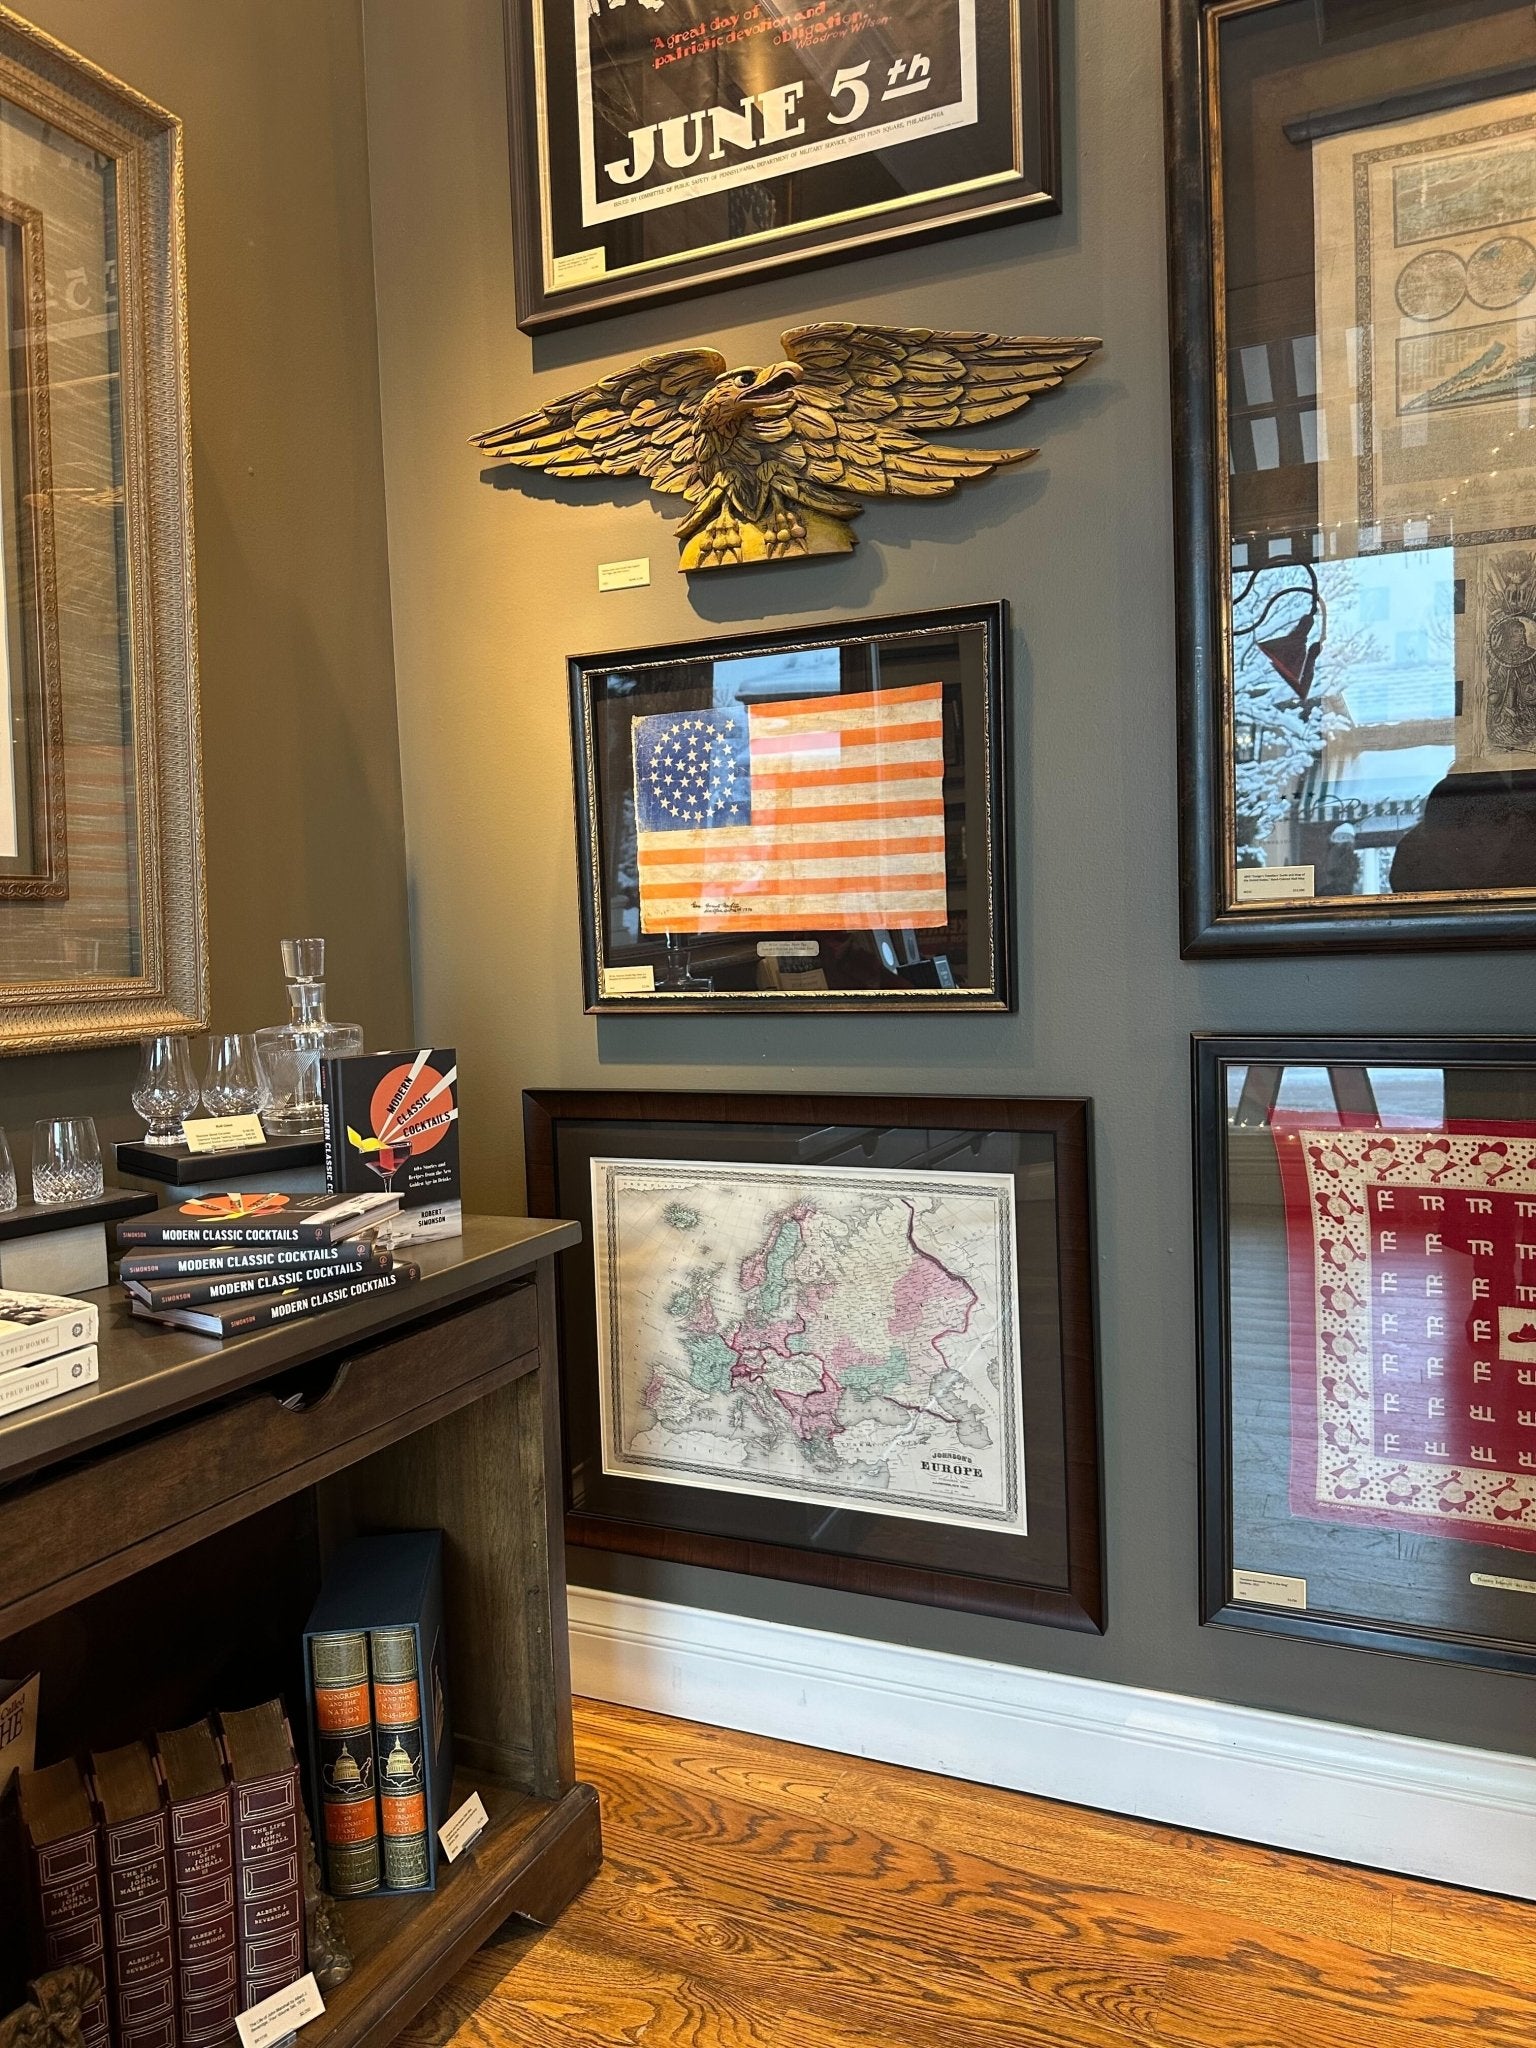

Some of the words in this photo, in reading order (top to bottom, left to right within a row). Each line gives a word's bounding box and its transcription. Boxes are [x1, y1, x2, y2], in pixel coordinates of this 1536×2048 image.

[667, 23, 706, 49] great
[709, 12, 739, 32] day
[743, 4, 761, 21] of
[653, 35, 724, 70] patriotic
[726, 14, 791, 44] devotion
[794, 2, 826, 22] and
[795, 29, 847, 49] Woodrow
[603, 81, 806, 185] JUNE
[827, 52, 931, 126] 5th
[666, 186, 673, 194] OF
[673, 181, 691, 192] PUBLIC
[691, 176, 709, 187] SAFETY
[756, 154, 790, 169] DEPARTMENT
[799, 145, 823, 156] MILITARY
[848, 133, 866, 144] SOUTH
[867, 129, 881, 139] PENN
[906, 111, 945, 127] PHILADELPHIA
[386, 1075, 413, 1115] MODERN
[396, 1093, 431, 1126] CLASSIC
[323, 1103, 332, 1140] MODERN
[402, 1111, 452, 1137] COCKTAILS
[324, 1142, 333, 1180] CLASSIC
[1377, 1190, 1395, 1212] TR
[1418, 1195, 1445, 1211] TR
[1465, 1197, 1493, 1215] TR
[418, 1216, 446, 1228] SIMONSON
[421, 1208, 442, 1219] ROBERT
[122, 1231, 147, 1239] SIMONSON
[162, 1229, 200, 1241] MODERN
[202, 1229, 243, 1241] CLASSIC
[245, 1229, 299, 1241] COCKTAILS
[1380, 1230, 1397, 1253] TR
[1425, 1233, 1443, 1256] TR
[1467, 1239, 1494, 1256] TR
[129, 1265, 159, 1273] SIMONSON
[178, 1257, 225, 1272] MODERN
[227, 1253, 275, 1268] CLASSIC
[277, 1247, 339, 1264] COCKTAILS
[161, 1293, 191, 1304] SIMONSON
[209, 1279, 255, 1297] MODERN
[257, 1271, 303, 1289] CLASSIC
[305, 1261, 363, 1281] COCKTAILS
[1381, 1272, 1398, 1294] TR
[1426, 1274, 1443, 1297] TR
[1472, 1277, 1490, 1301] TR
[230, 1315, 256, 1328] SIMONSON
[271, 1298, 308, 1319] MODERN
[310, 1287, 348, 1308] CLASSIC
[350, 1274, 397, 1299] COCKTAILS
[1382, 1313, 1398, 1334] TR
[1427, 1316, 1444, 1338] TR
[1473, 1319, 1491, 1343] TR
[1382, 1353, 1399, 1375] TR
[1427, 1356, 1444, 1379] TR
[1474, 1360, 1491, 1384] TR
[1383, 1392, 1400, 1414] TR
[1428, 1397, 1445, 1419] TR
[1469, 1405, 1496, 1423] TR
[1384, 1433, 1400, 1453] TR
[1425, 1441, 1450, 1457] TR
[932, 1452, 973, 1464] JOHNSON'S
[1470, 1445, 1497, 1463] TR
[920, 1460, 983, 1478] EUROPE
[323, 1690, 361, 1701] CONGRESS
[378, 1687, 415, 1695] CONGRESS
[327, 1706, 360, 1716] NATION
[381, 1701, 413, 1710] NATION
[252, 1826, 268, 1835] THE
[269, 1821, 286, 1831] LIFE
[250, 1836, 288, 1850] MARSHALL
[260, 1832, 281, 1844] JOHN
[186, 1849, 202, 1857] THE
[204, 1842, 221, 1852] LIFE
[184, 1857, 224, 1873] MARSHALL
[194, 1854, 217, 1866] JOHN
[121, 1869, 138, 1879] THE
[140, 1862, 158, 1873] LIFE
[135, 1872, 145, 1880] OF
[52, 1889, 69, 1899] THE
[71, 1881, 90, 1893] LIFE
[119, 1878, 161, 1896] MARSHALL
[130, 1875, 153, 1888] JOHN
[50, 1896, 94, 1916] MARSHALL
[61, 1893, 85, 1907] JOHN
[254, 1910, 290, 1925] BEVERIDGE
[256, 1905, 282, 1917] ALBERT
[189, 1933, 226, 1949] BEVERIDGE
[190, 1928, 217, 1941] ALBERT
[126, 1958, 165, 1975] BEVERIDGE
[128, 1954, 154, 1966] ALBERT
